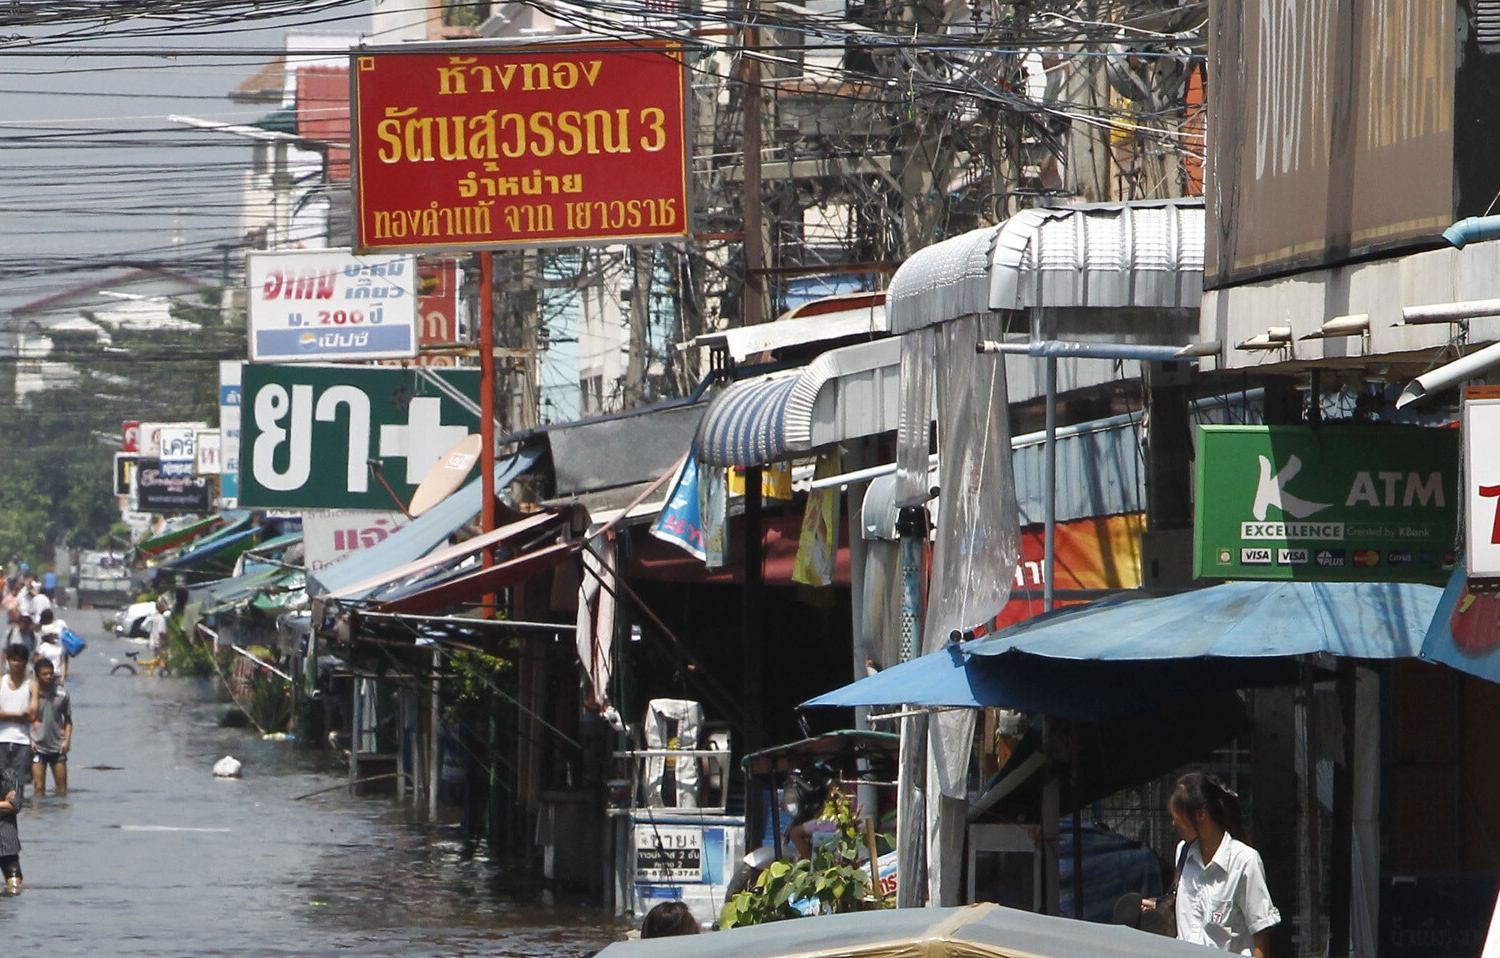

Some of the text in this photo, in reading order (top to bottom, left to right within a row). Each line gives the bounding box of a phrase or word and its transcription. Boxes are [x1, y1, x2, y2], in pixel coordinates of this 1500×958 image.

[437, 56, 603, 95] ห้างทอง
[376, 105, 667, 172] รัตนสุวรรณ 3
[457, 168, 583, 198] จำหน่าย
[373, 196, 678, 240] ทองคำแท้ จาก เยาวราช
[317, 309, 365, 326] 200
[252, 382, 372, 493] ยา
[1343, 470, 1447, 508] ATM
[1244, 524, 1342, 538] EXCELLENCE
[1245, 550, 1270, 561] VISA
[1281, 550, 1307, 562] VISA
[1323, 555, 1345, 567] PLUS
